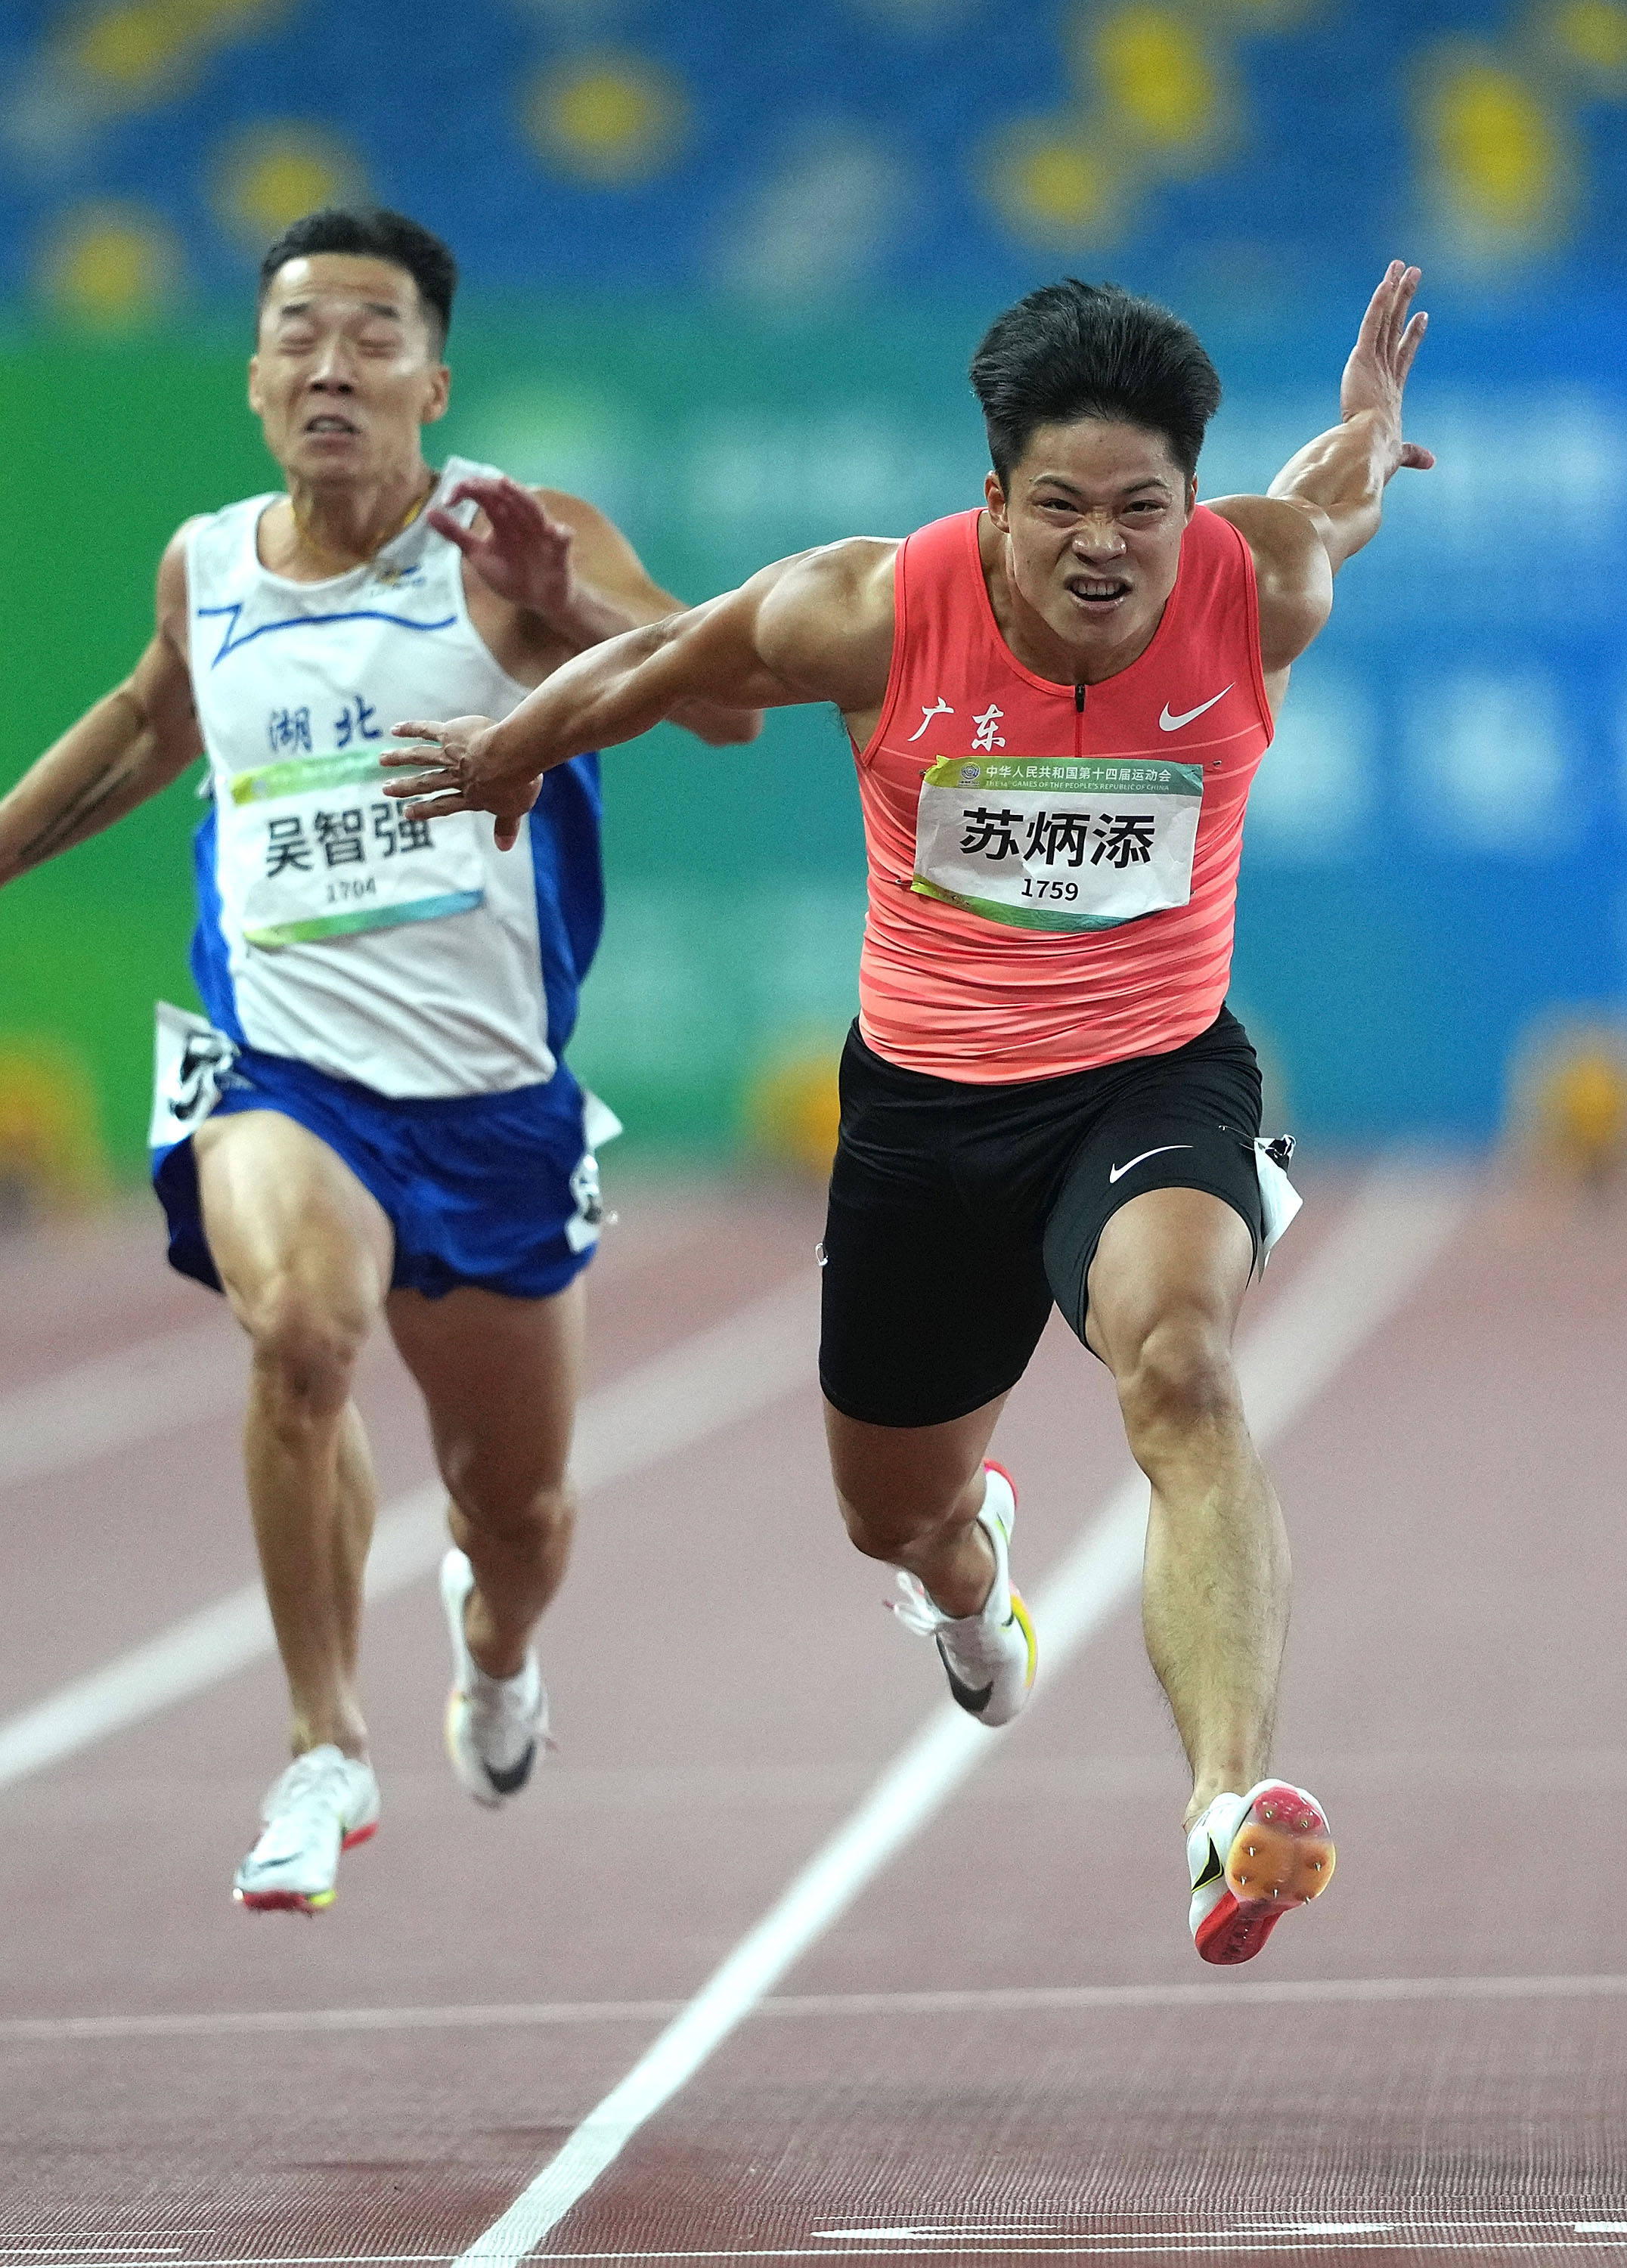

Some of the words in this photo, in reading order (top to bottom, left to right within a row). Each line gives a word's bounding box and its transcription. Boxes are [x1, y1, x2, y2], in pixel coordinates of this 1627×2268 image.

[268, 694, 384, 753] 湖北
[907, 696, 1006, 751] 广东
[986, 764, 1172, 782] 中华人民共和国第十四届运动会
[1065, 782, 1099, 790] PEOPLE'S
[265, 796, 435, 878] 吴智强
[959, 807, 1155, 869] 苏炳添
[327, 877, 377, 903] 1704
[1021, 878, 1079, 901] 1759
